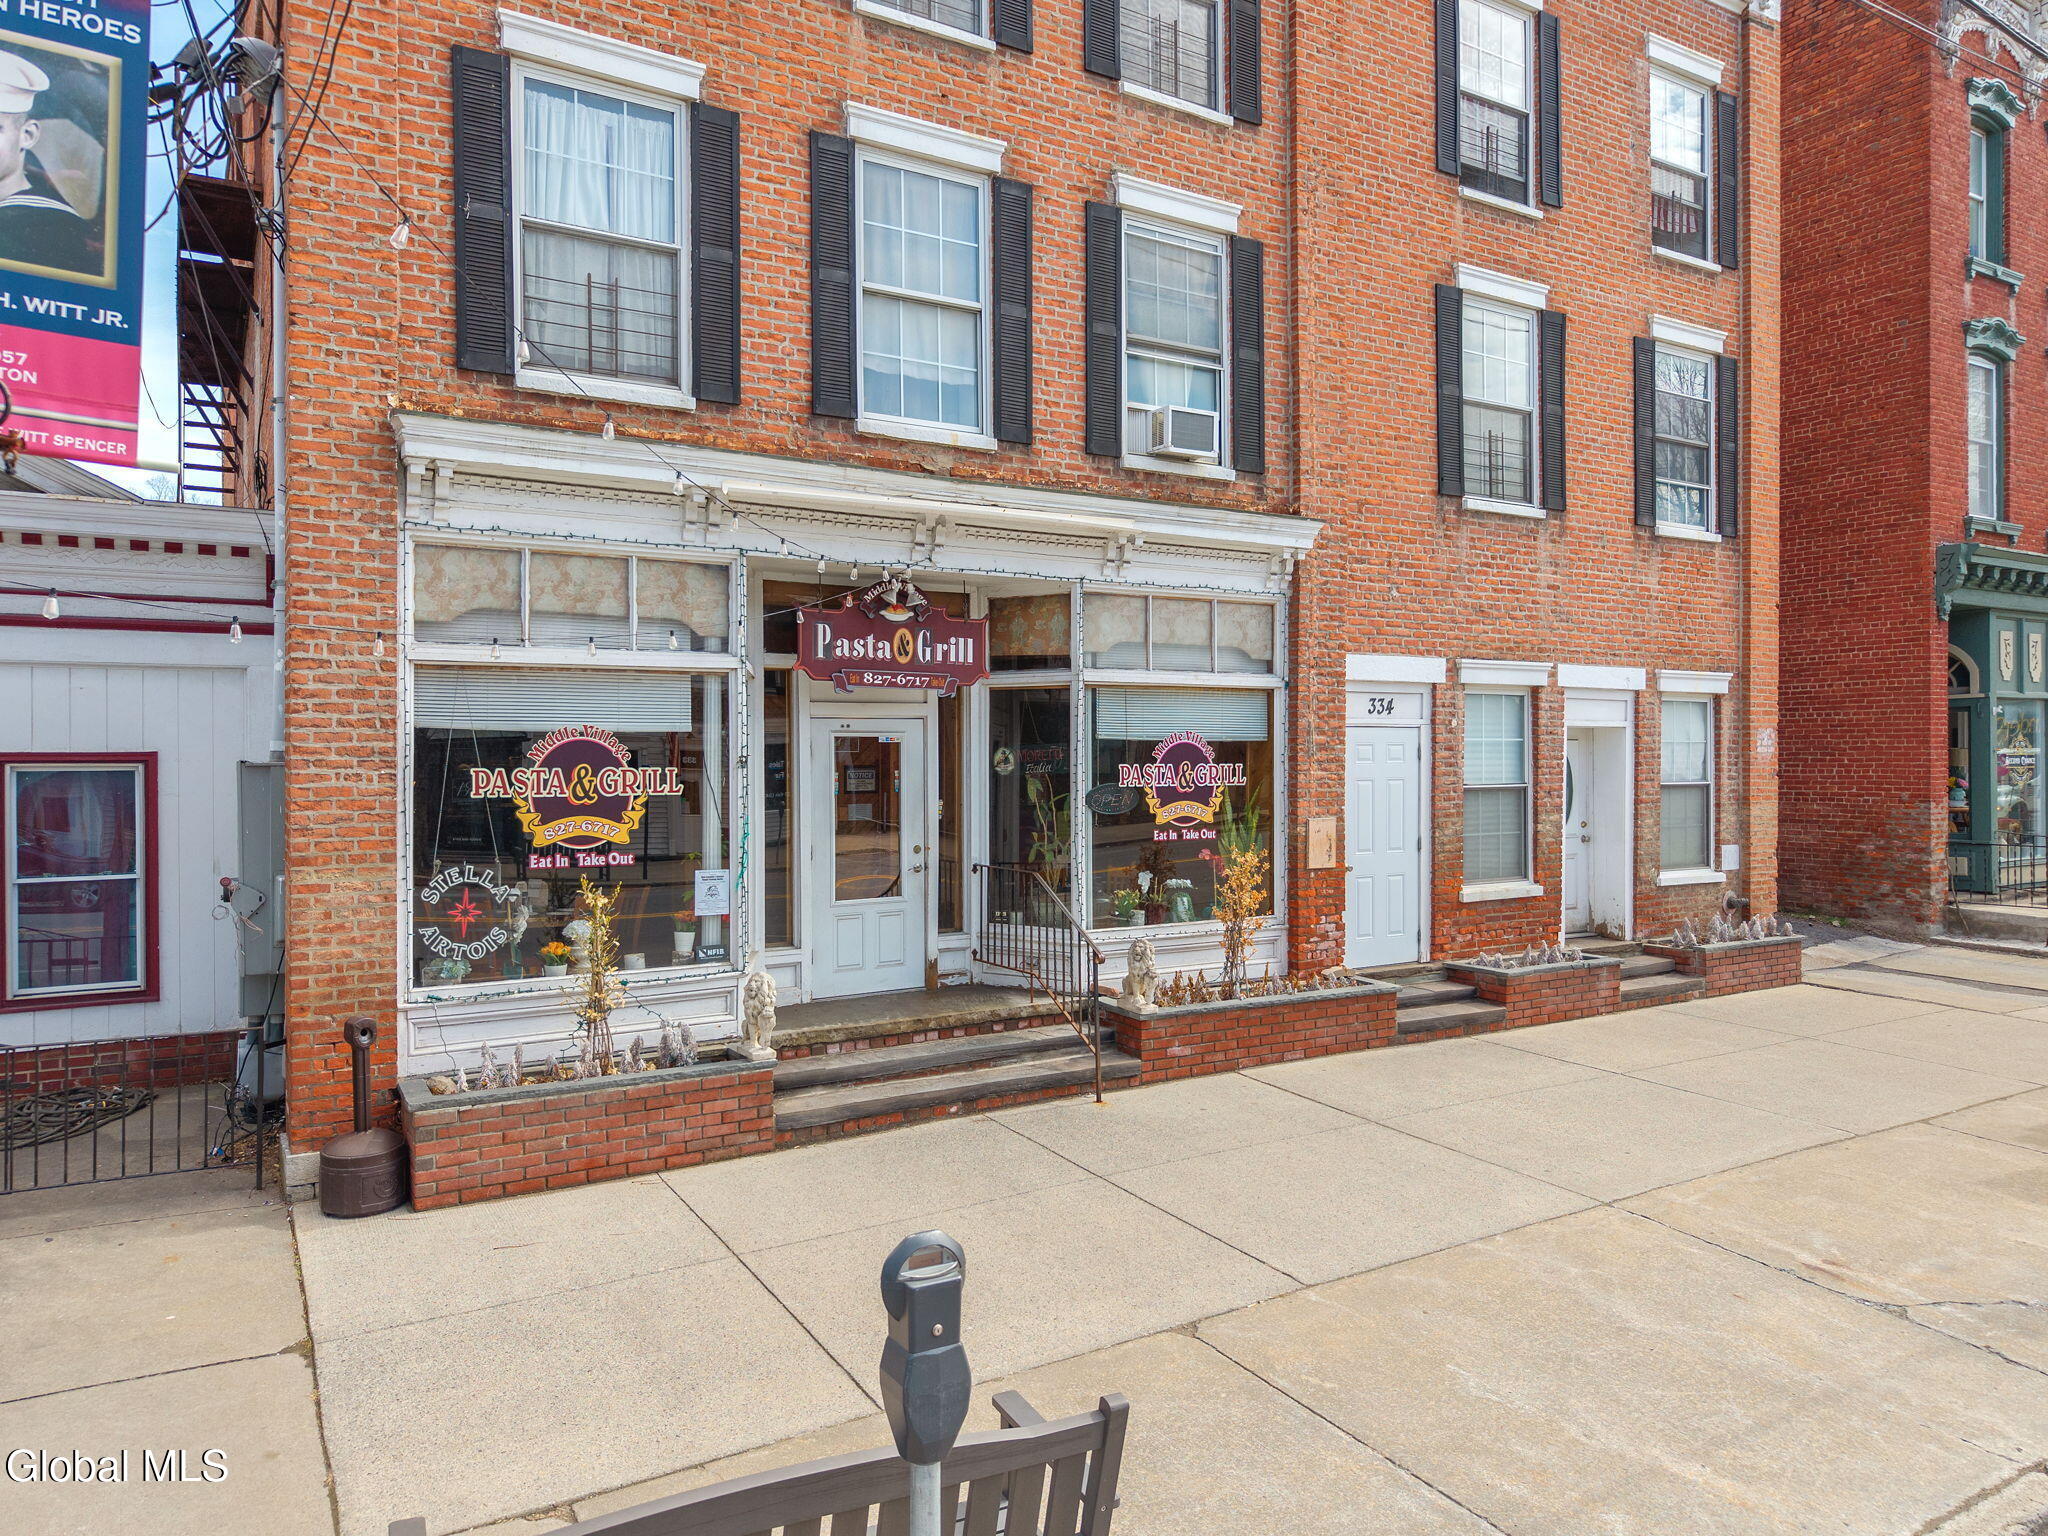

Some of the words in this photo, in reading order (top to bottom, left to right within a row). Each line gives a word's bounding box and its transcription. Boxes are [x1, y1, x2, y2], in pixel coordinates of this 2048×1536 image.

[20, 0, 142, 44] HEROES
[23, 295, 88, 321] WITT
[91, 308, 129, 329] JR.
[52, 434, 128, 455] SPENCER
[863, 580, 895, 603] Middl
[898, 581, 928, 606] Viage
[817, 623, 892, 660] Pasta
[898, 631, 910, 657] &
[917, 629, 974, 664] Grill
[863, 671, 930, 688] 827-6717
[1367, 697, 1395, 715] 334
[527, 726, 580, 762] Middle
[582, 724, 632, 762] Village
[1152, 731, 1183, 759] Middle
[1185, 730, 1216, 759] Village
[470, 767, 568, 798] PASTA
[567, 763, 598, 805] &
[597, 766, 684, 796] GRILL
[849, 771, 873, 779] NOTICE
[1118, 763, 1177, 787] PASTA
[1177, 760, 1195, 793] &
[1194, 763, 1247, 786] GRILL
[1091, 793, 1134, 807] OPEN
[1161, 803, 1209, 820] 827-6717
[543, 820, 620, 841] 827-6717
[1153, 830, 1167, 841] Eat
[1169, 829, 1178, 840] In
[1181, 829, 1199, 840] Take
[1200, 828, 1217, 839] Out
[529, 854, 553, 869] Eat
[555, 853, 571, 868] In
[576, 853, 606, 868] Take
[608, 852, 635, 867] Out
[421, 865, 510, 904] STELLA
[419, 926, 507, 960] ARTOIS
